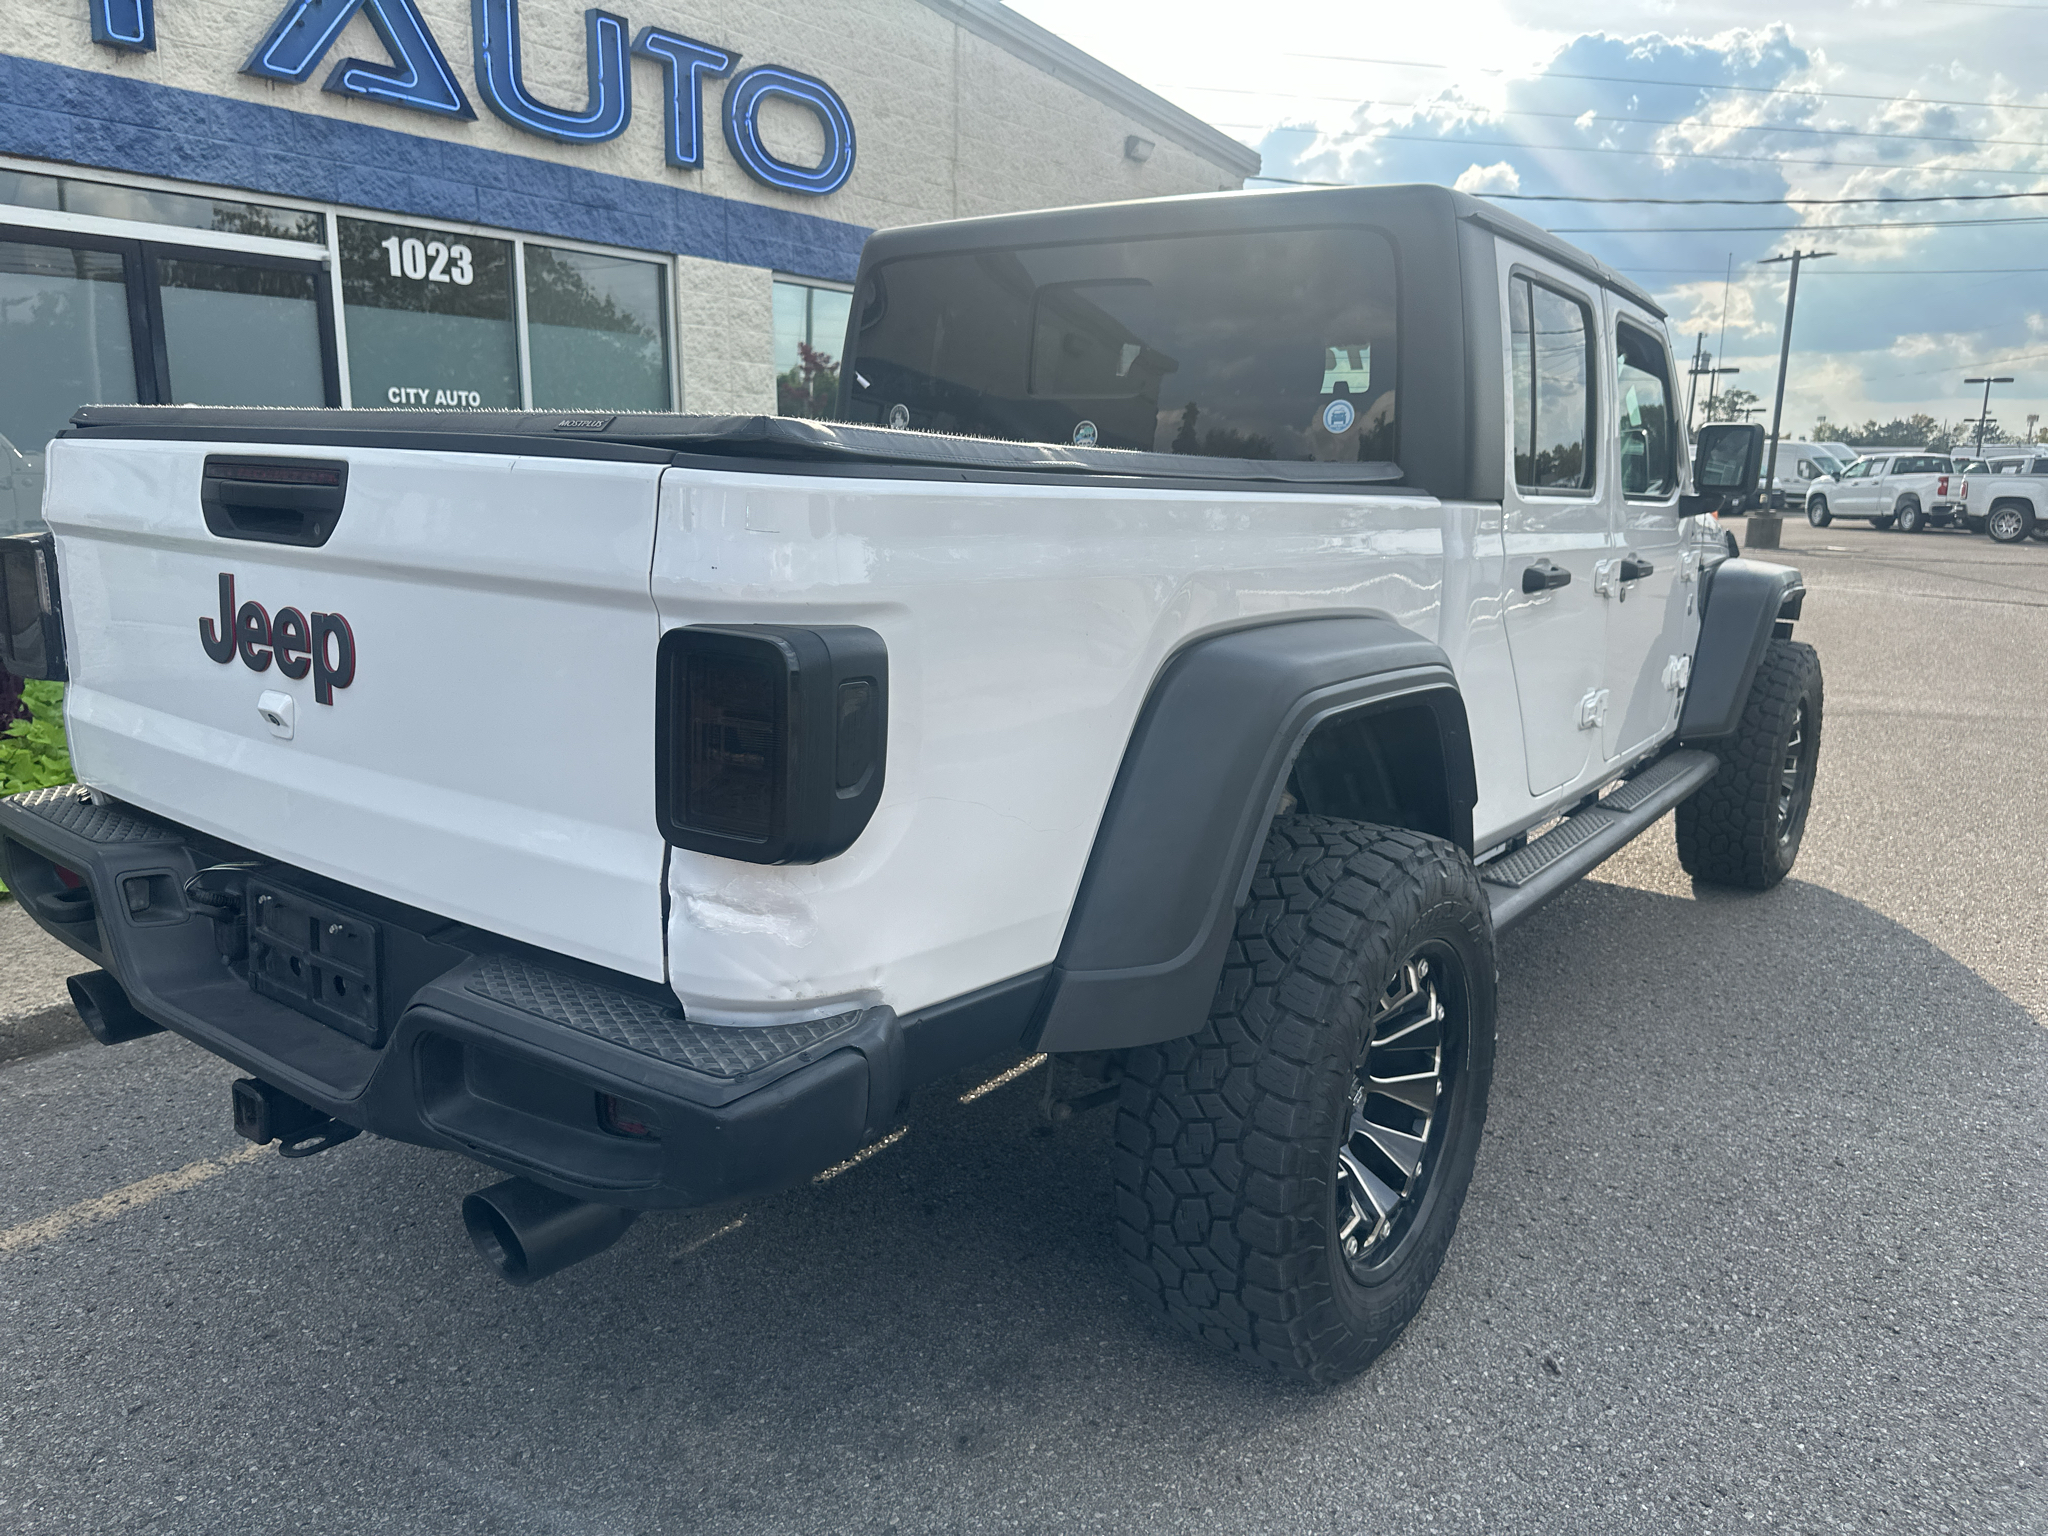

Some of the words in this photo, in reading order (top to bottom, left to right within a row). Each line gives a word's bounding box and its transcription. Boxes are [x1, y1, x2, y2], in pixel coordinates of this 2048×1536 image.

[238, 0, 857, 197] AUTO
[381, 235, 474, 286] 1023
[387, 386, 430, 405] CITY
[434, 389, 481, 407] AUTO
[558, 419, 604, 428] MOSTPLUS
[198, 572, 356, 706] Jeep
